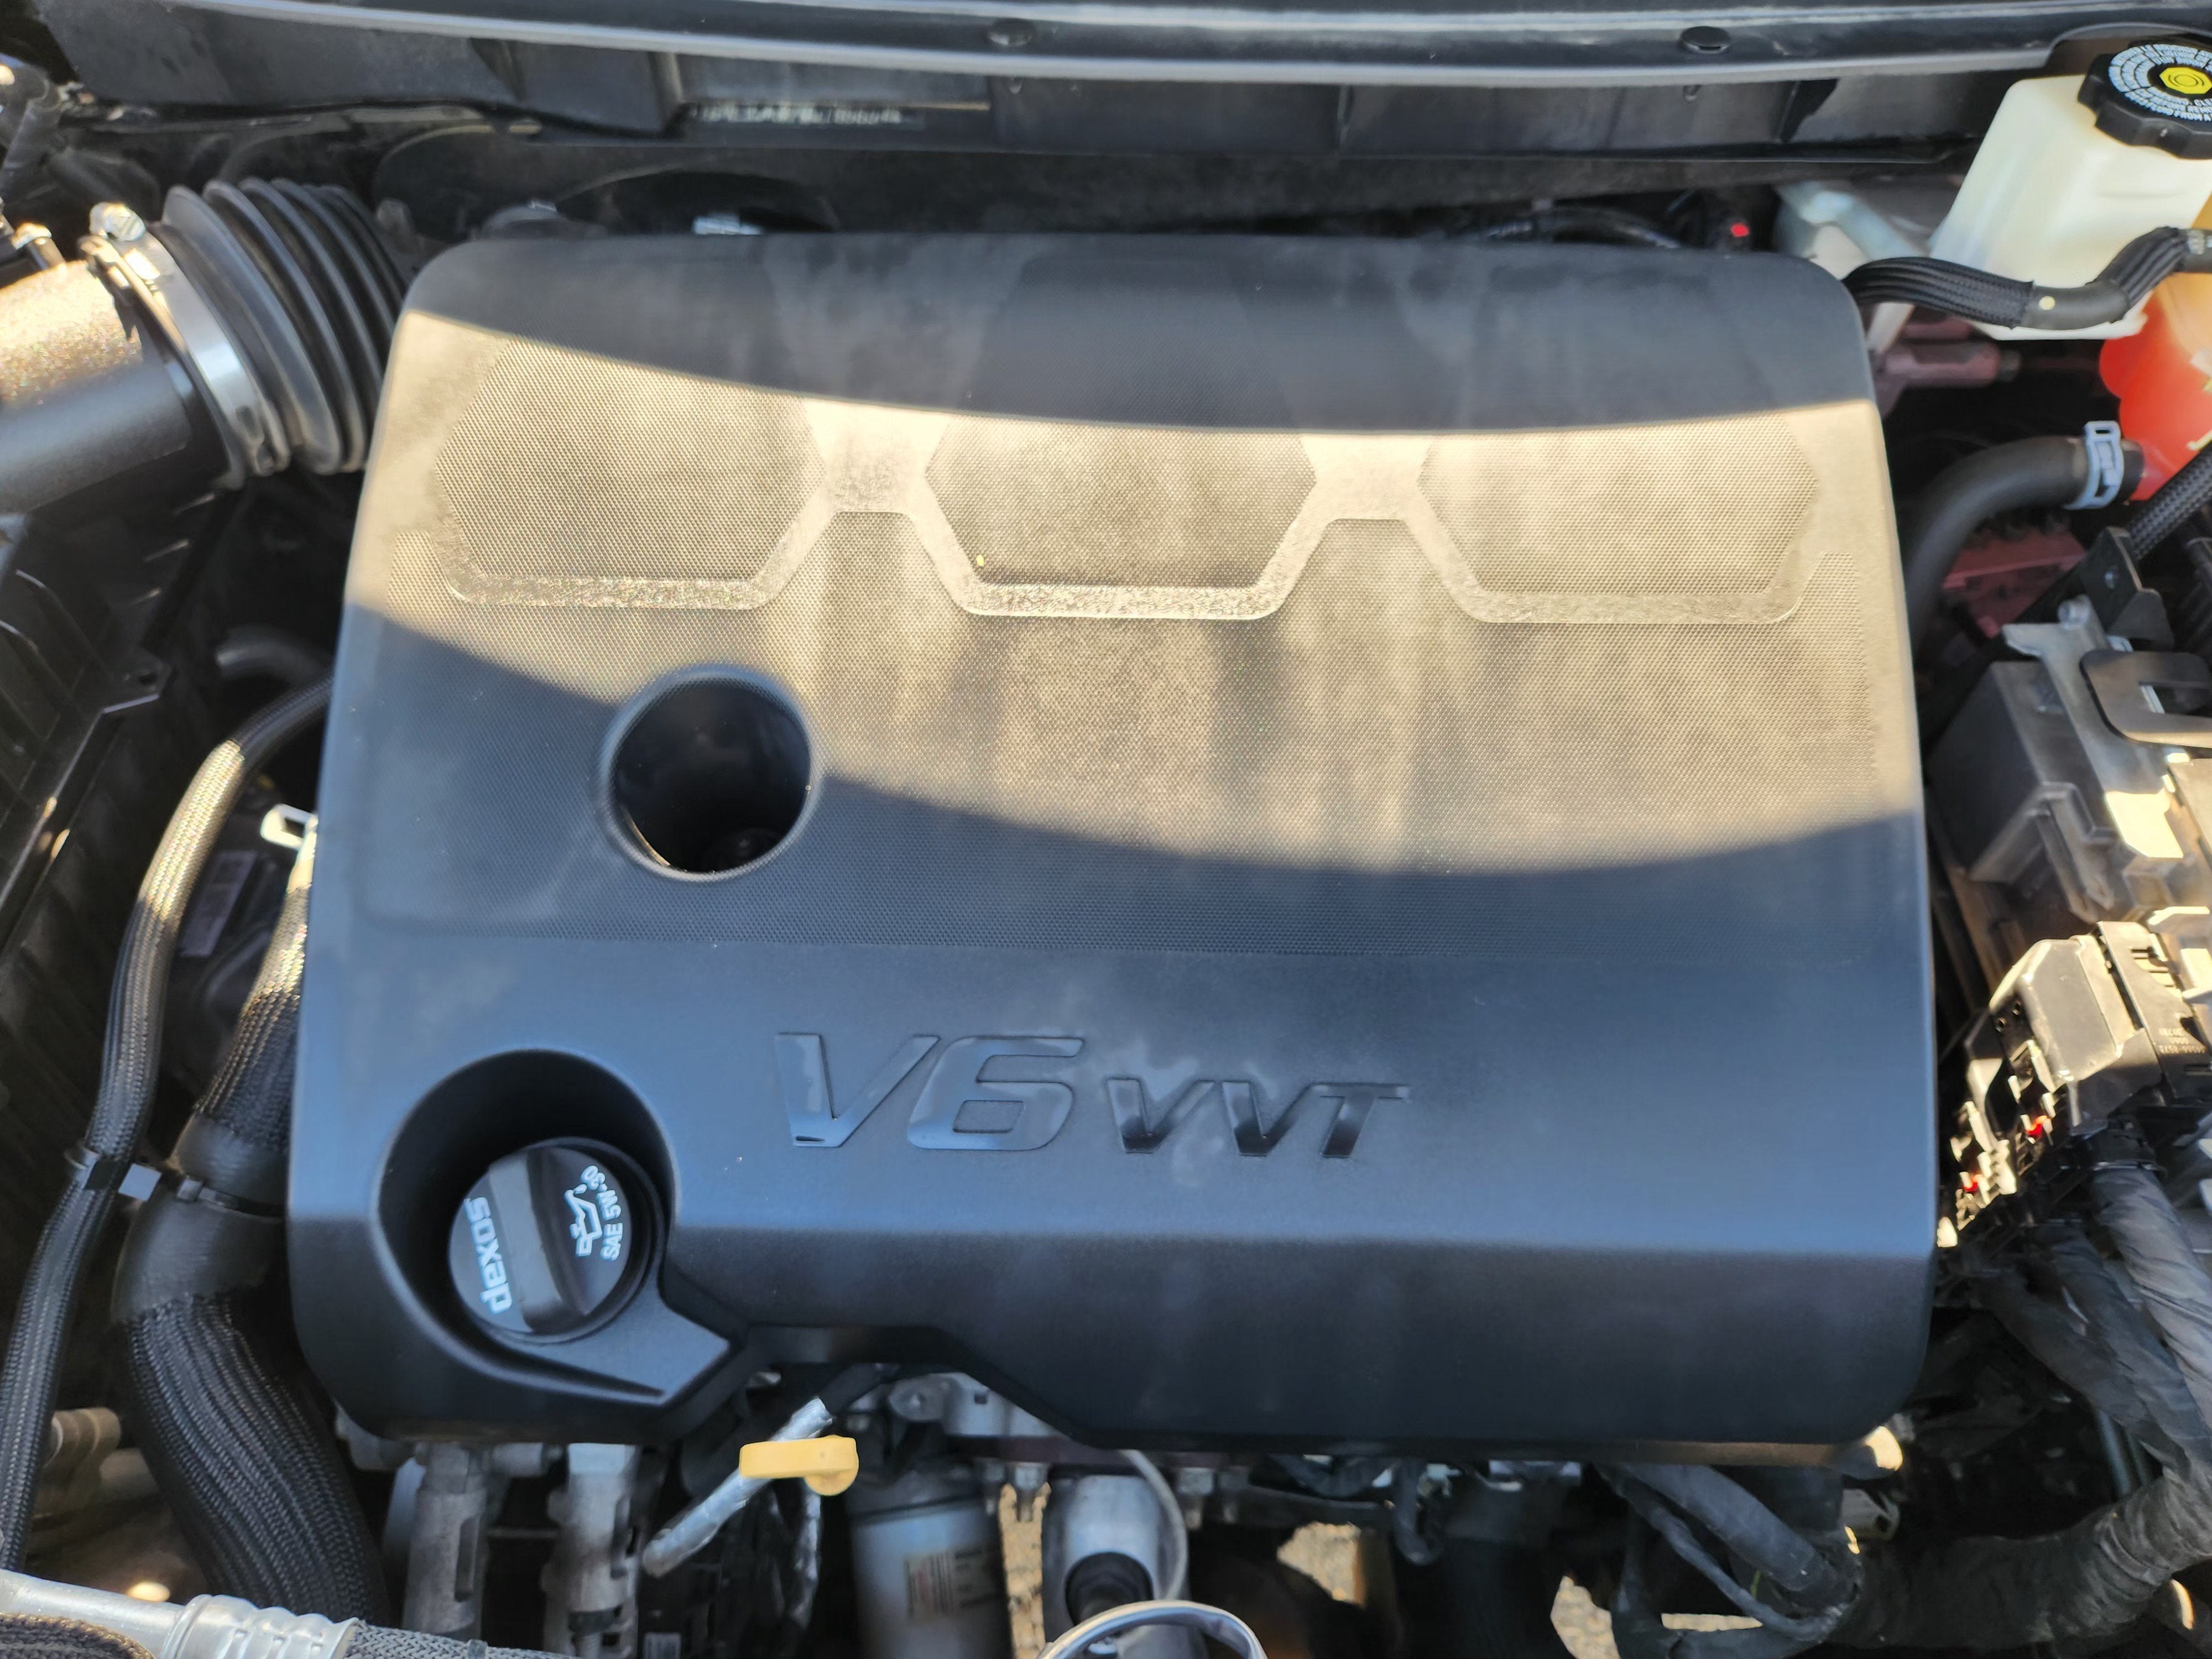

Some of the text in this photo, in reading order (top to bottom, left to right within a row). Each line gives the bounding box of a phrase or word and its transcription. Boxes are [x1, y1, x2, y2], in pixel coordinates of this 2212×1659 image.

[776, 1032, 1410, 1157] V6 VVT
[463, 1197, 513, 1314] dexos
[580, 1165, 623, 1261] SAE 5W-30
